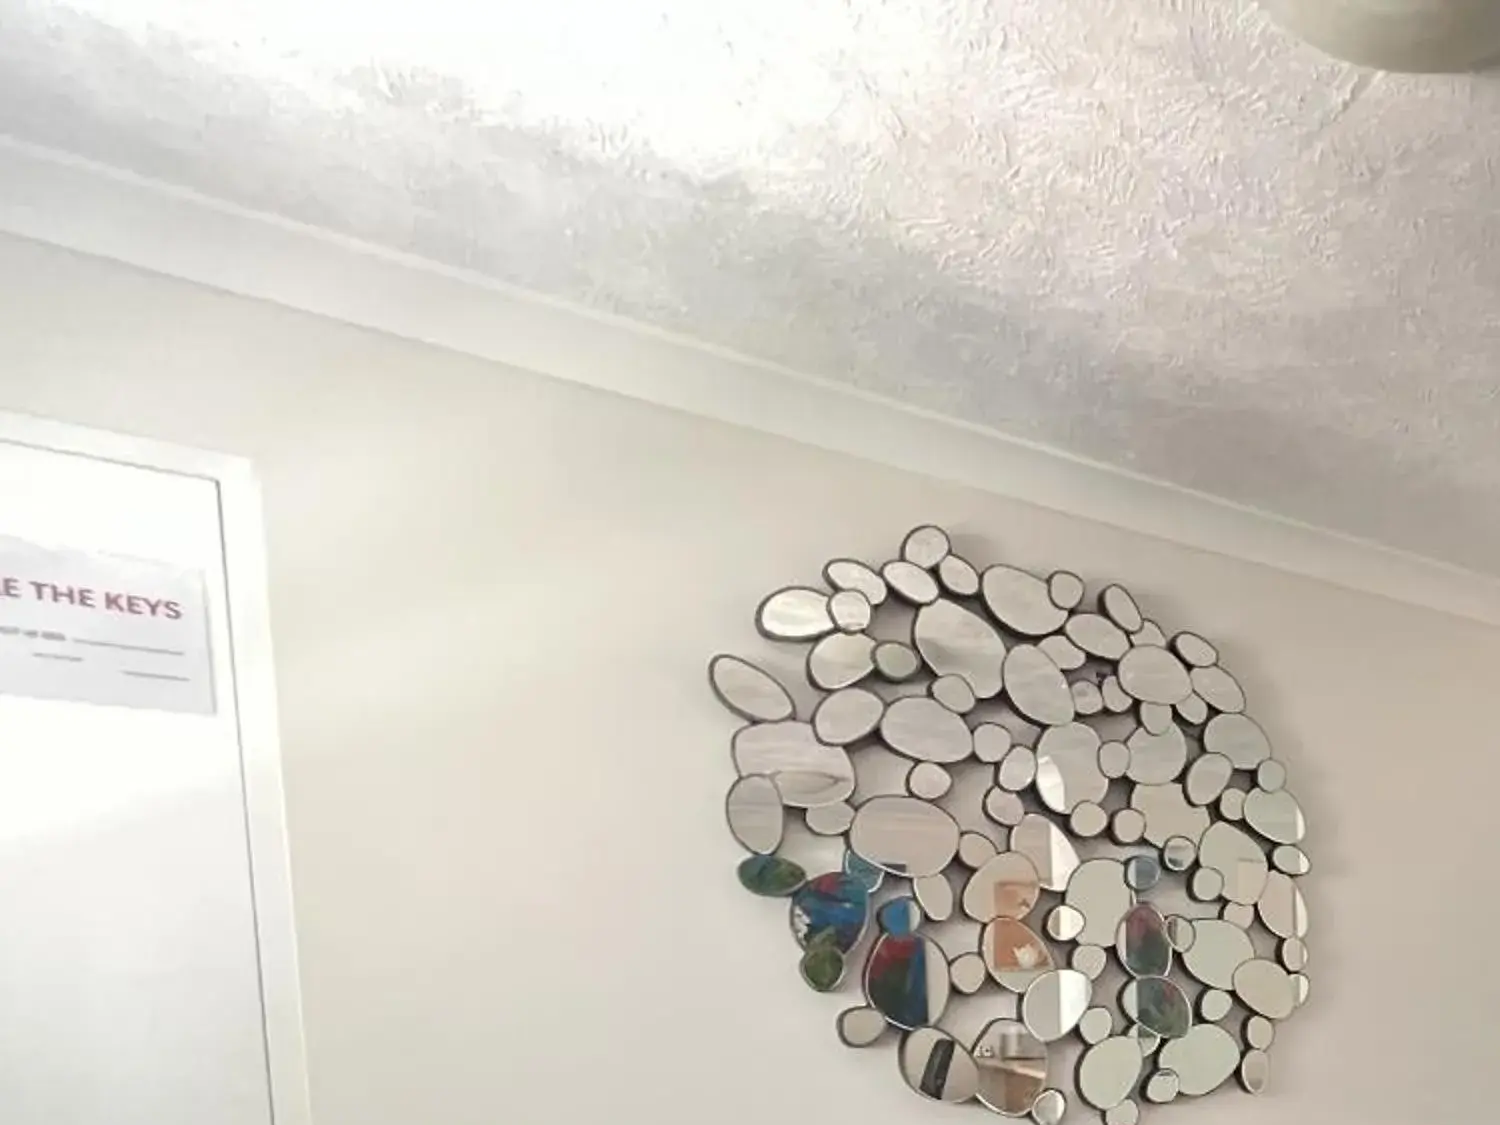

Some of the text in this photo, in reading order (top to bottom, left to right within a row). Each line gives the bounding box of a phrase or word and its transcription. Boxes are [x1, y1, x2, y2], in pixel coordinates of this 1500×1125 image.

[0, 577, 183, 620] E THE KEYS
